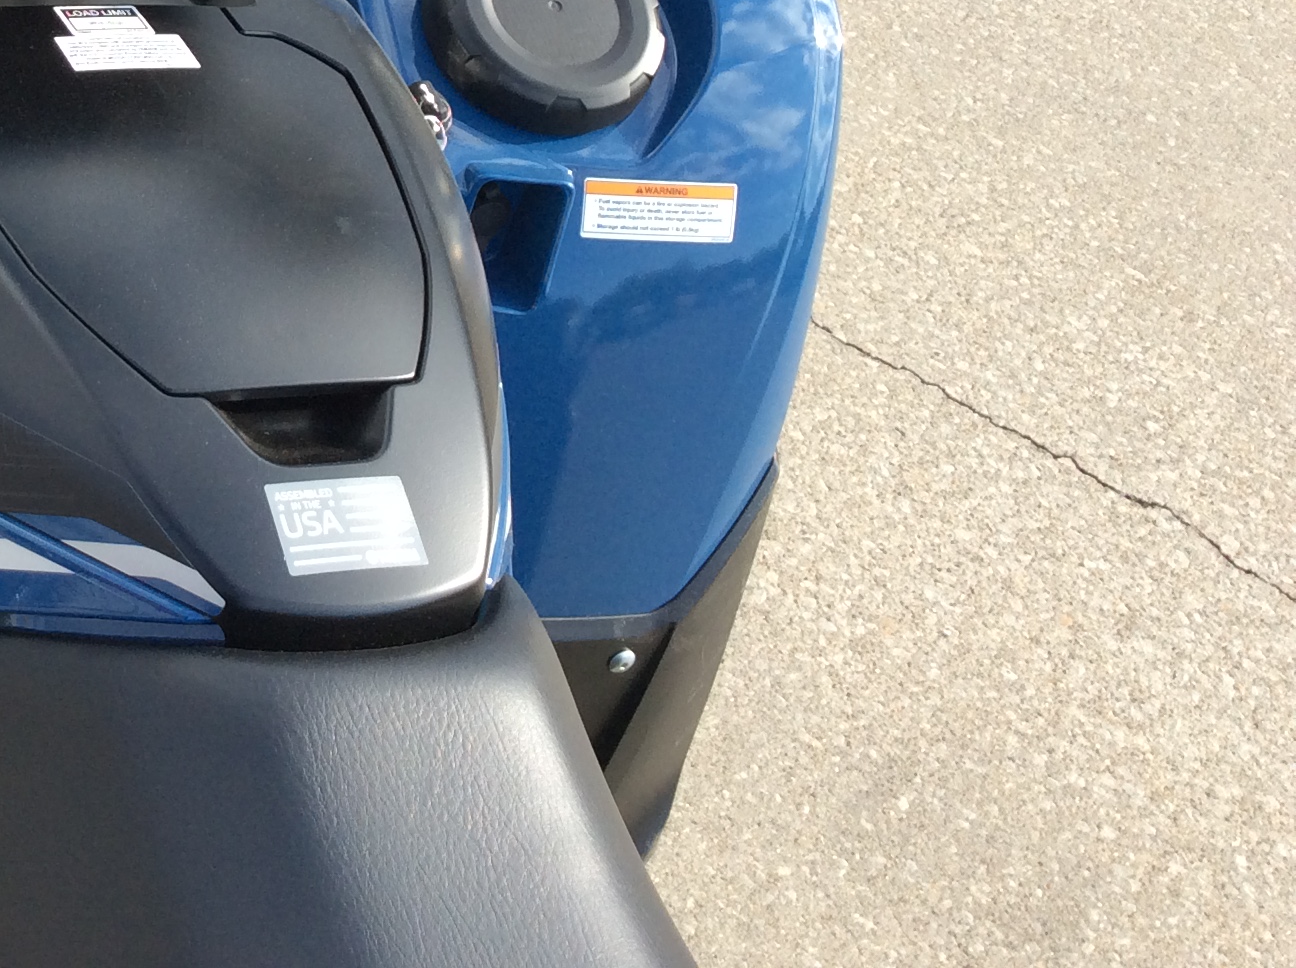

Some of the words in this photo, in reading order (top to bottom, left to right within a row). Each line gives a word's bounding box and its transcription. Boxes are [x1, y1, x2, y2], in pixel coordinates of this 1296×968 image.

[645, 186, 688, 196] WARNING
[274, 487, 333, 501] ASSEMBLED
[291, 501, 301, 511] IN
[302, 500, 322, 509] THE
[280, 509, 344, 539] USA
